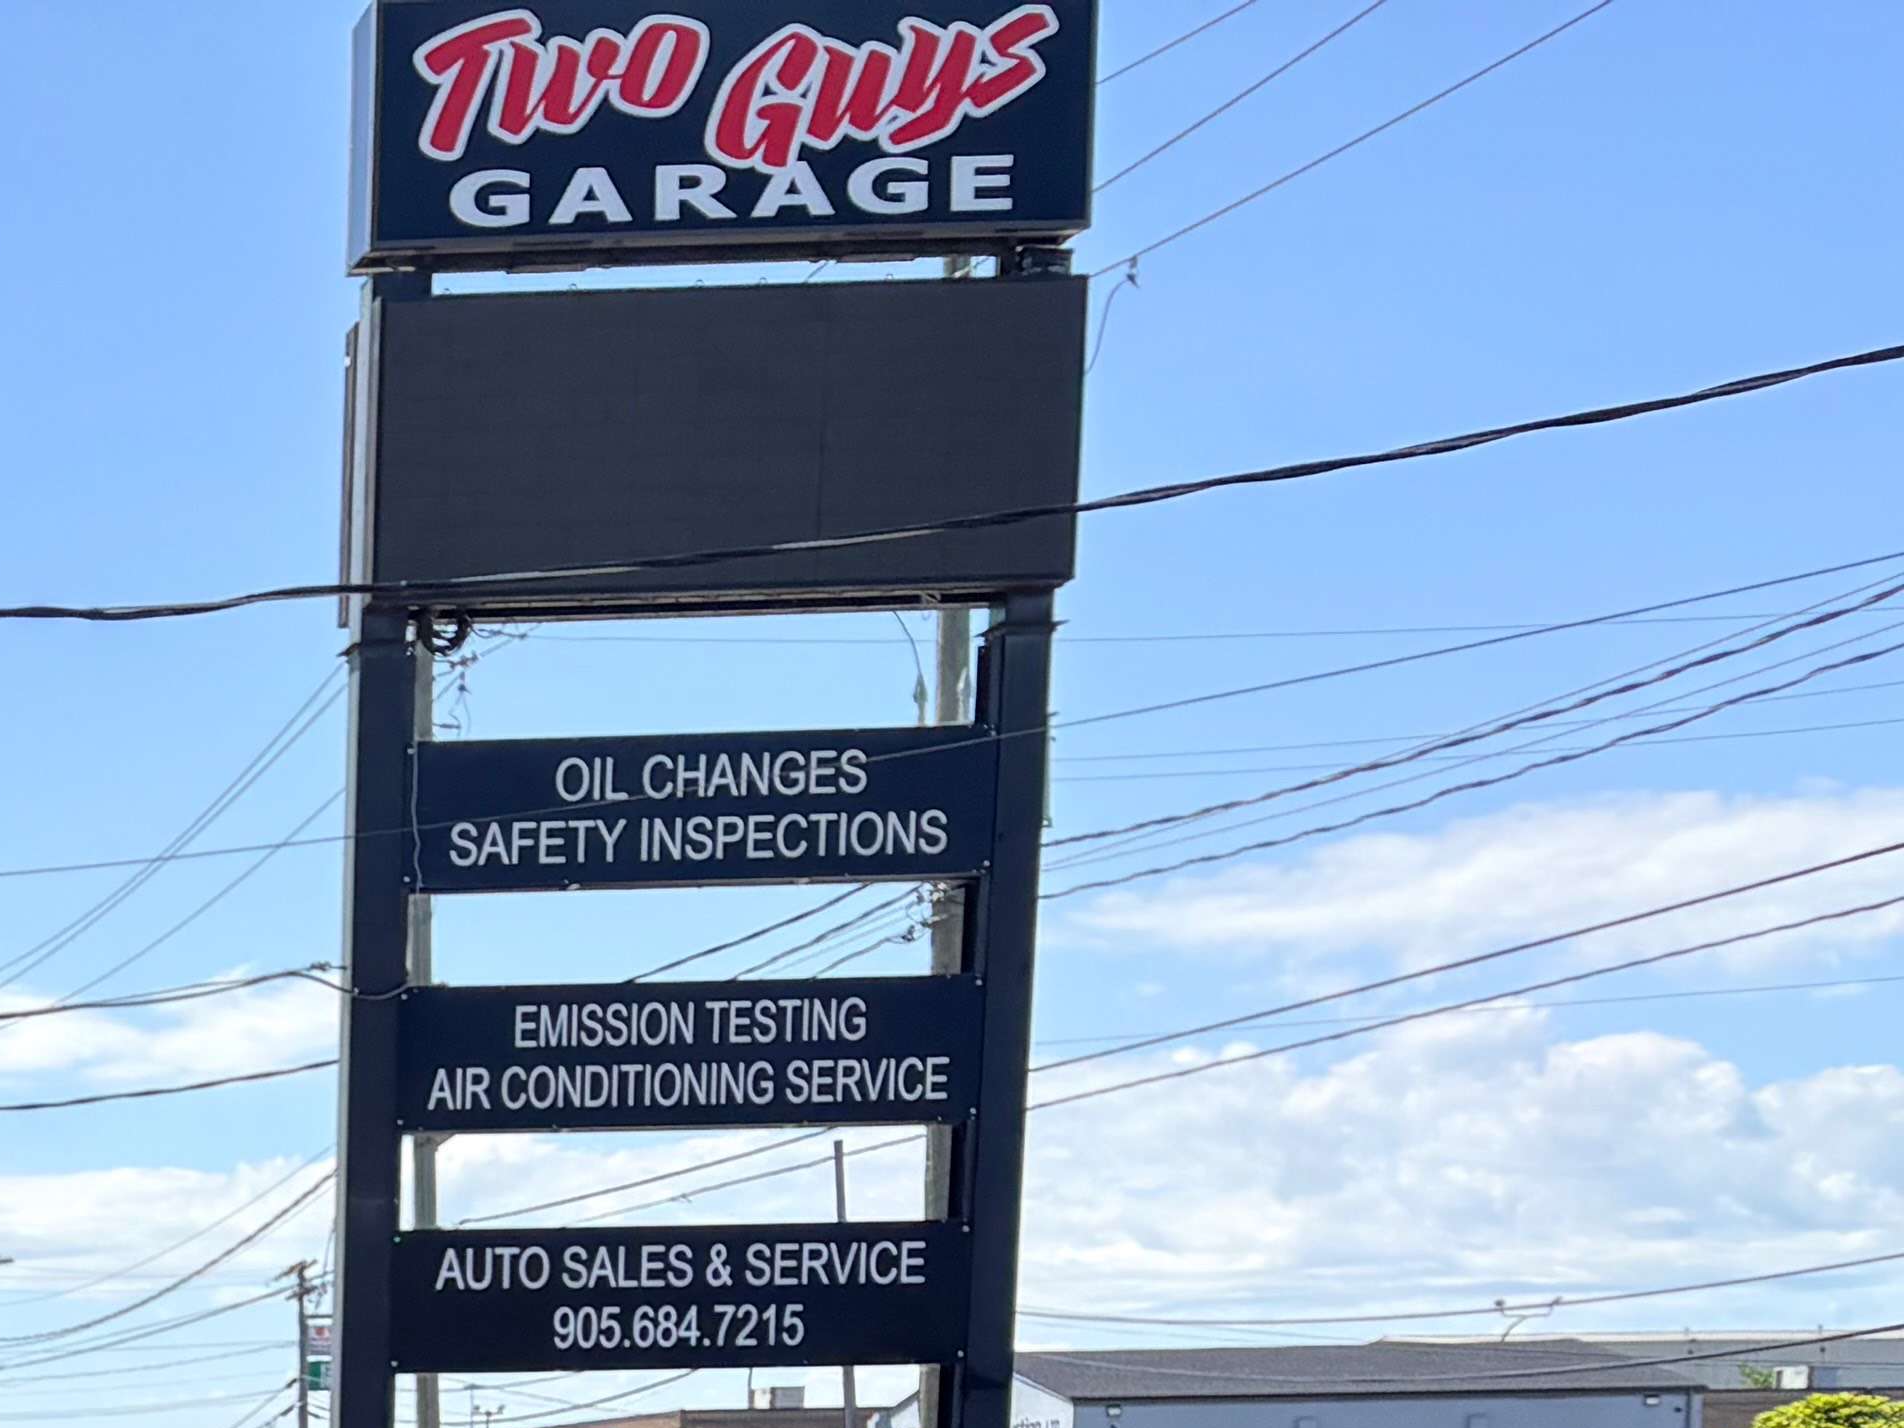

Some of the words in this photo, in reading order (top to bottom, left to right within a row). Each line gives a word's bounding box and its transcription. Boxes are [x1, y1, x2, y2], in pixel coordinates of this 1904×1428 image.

[704, 4, 1059, 172] Guys
[449, 155, 1015, 228] GARAGE
[555, 756, 628, 801] OIL
[642, 749, 868, 799] CHANGES
[449, 818, 625, 867] SAFETY
[640, 809, 948, 861] INSPECTIONS
[514, 1002, 694, 1048] EMISSION
[705, 997, 867, 1044] TESTING
[427, 1066, 491, 1111] AIR
[501, 1061, 774, 1110] CONDITIONING
[785, 1056, 950, 1102] SERVICE
[435, 1245, 550, 1291] AUTO
[561, 1244, 693, 1290] SALES
[706, 1243, 733, 1288] &
[745, 1241, 926, 1286] SERVICE
[553, 1304, 804, 1349] 905.684.7215
